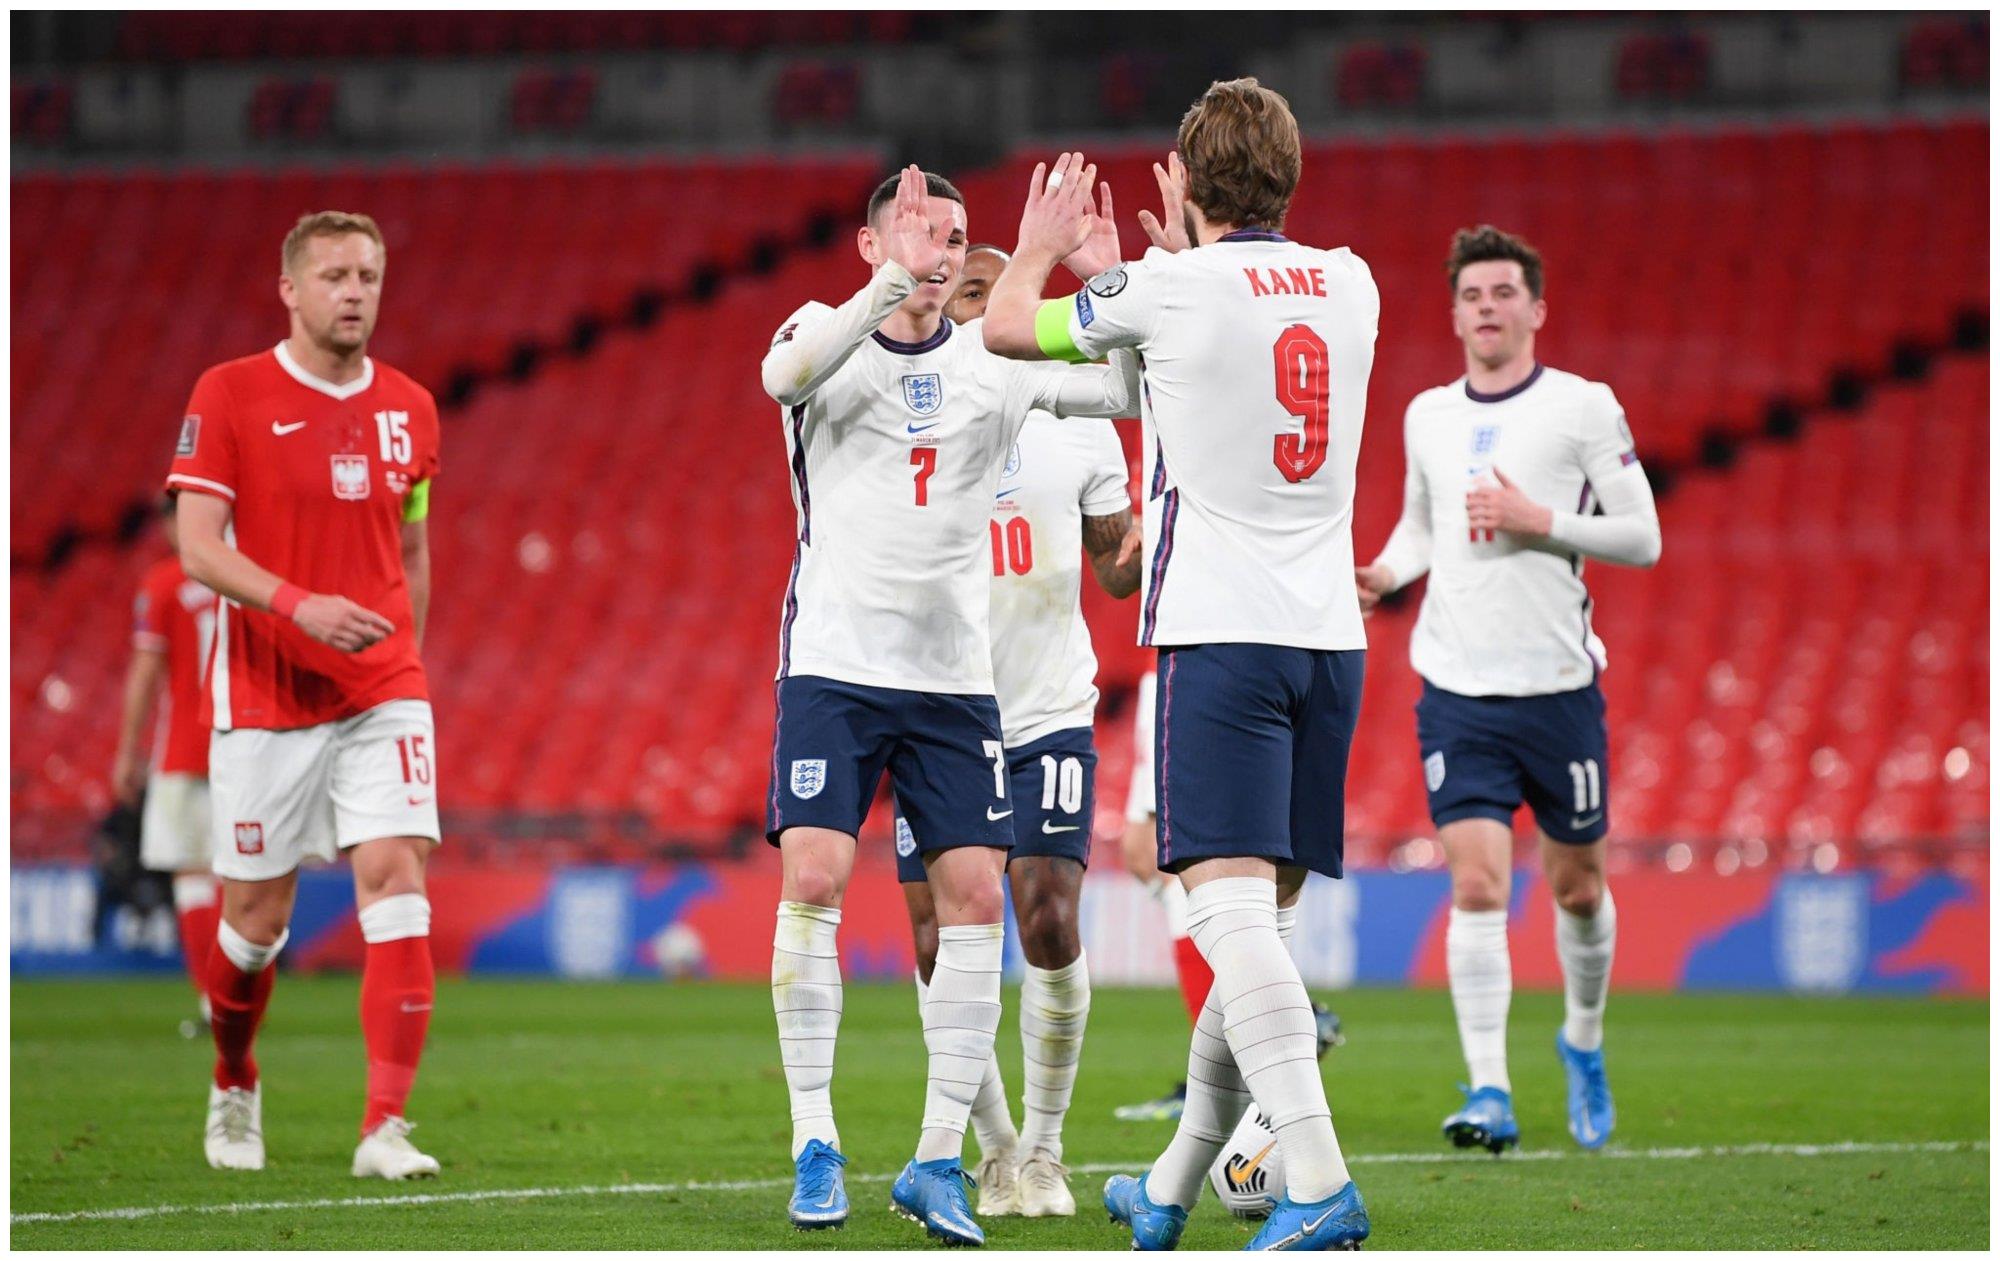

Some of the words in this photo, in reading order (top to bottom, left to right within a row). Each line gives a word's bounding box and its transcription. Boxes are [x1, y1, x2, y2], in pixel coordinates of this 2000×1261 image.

[1243, 267, 1327, 297] KANE
[1273, 324, 1329, 484] 9
[373, 409, 412, 465] 15
[909, 447, 937, 506] 7
[990, 516, 1033, 576] 10
[396, 735, 431, 785] 15
[982, 740, 1005, 799] 7
[1040, 754, 1083, 814] 10
[1568, 758, 1600, 813] 11
